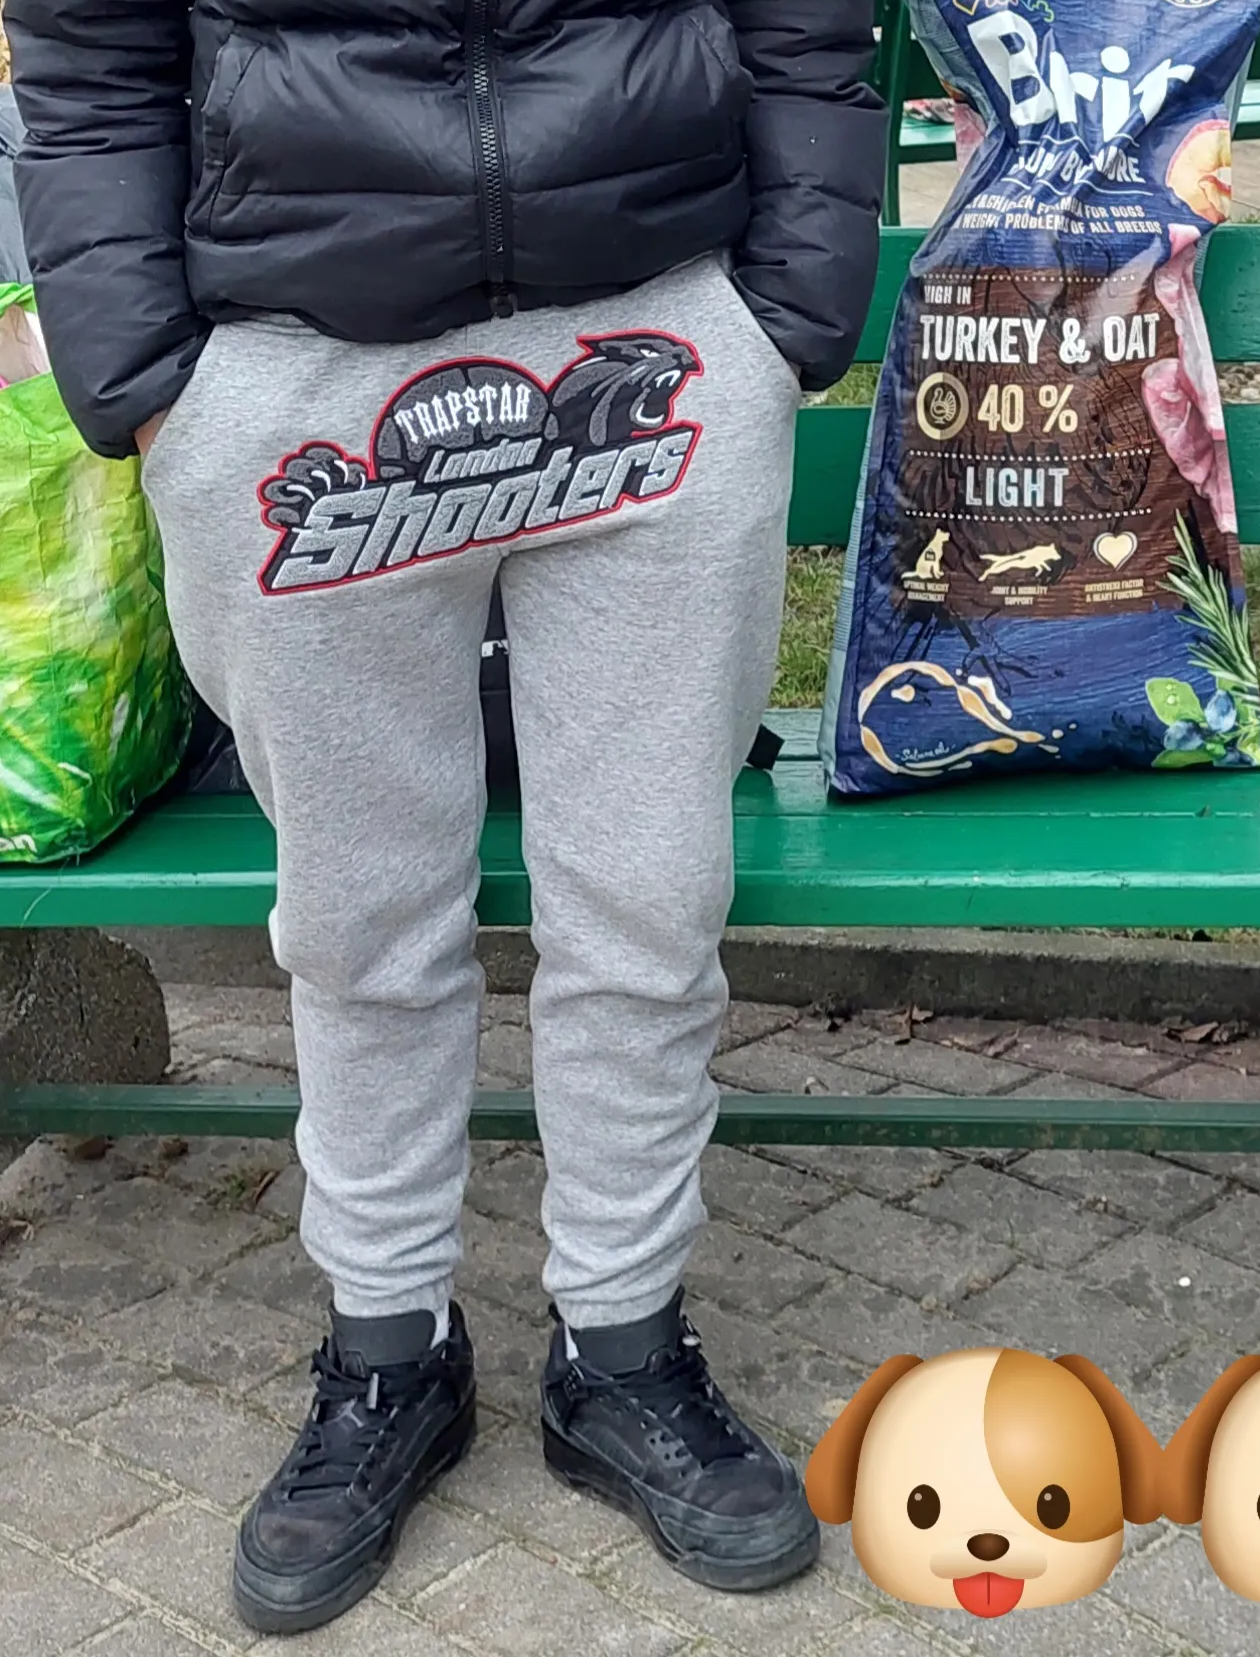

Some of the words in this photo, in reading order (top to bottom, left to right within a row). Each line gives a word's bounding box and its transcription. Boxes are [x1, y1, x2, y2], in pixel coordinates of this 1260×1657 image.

[1070, 222, 1085, 234] OF
[1089, 221, 1114, 233] ALL
[1114, 221, 1162, 234] BREEDS
[1085, 205, 1109, 218] FOR
[1110, 205, 1145, 218] DOGS
[956, 286, 972, 305] IN
[919, 314, 1046, 364] TURKEY
[1059, 318, 1091, 364] &
[1103, 312, 1161, 362] OAT
[394, 381, 532, 443] TRAPSTAR
[977, 384, 1025, 433] 40
[1038, 384, 1078, 433] %
[424, 437, 542, 483] London
[271, 430, 693, 589] Shooters
[965, 466, 1069, 507] LIGHT
